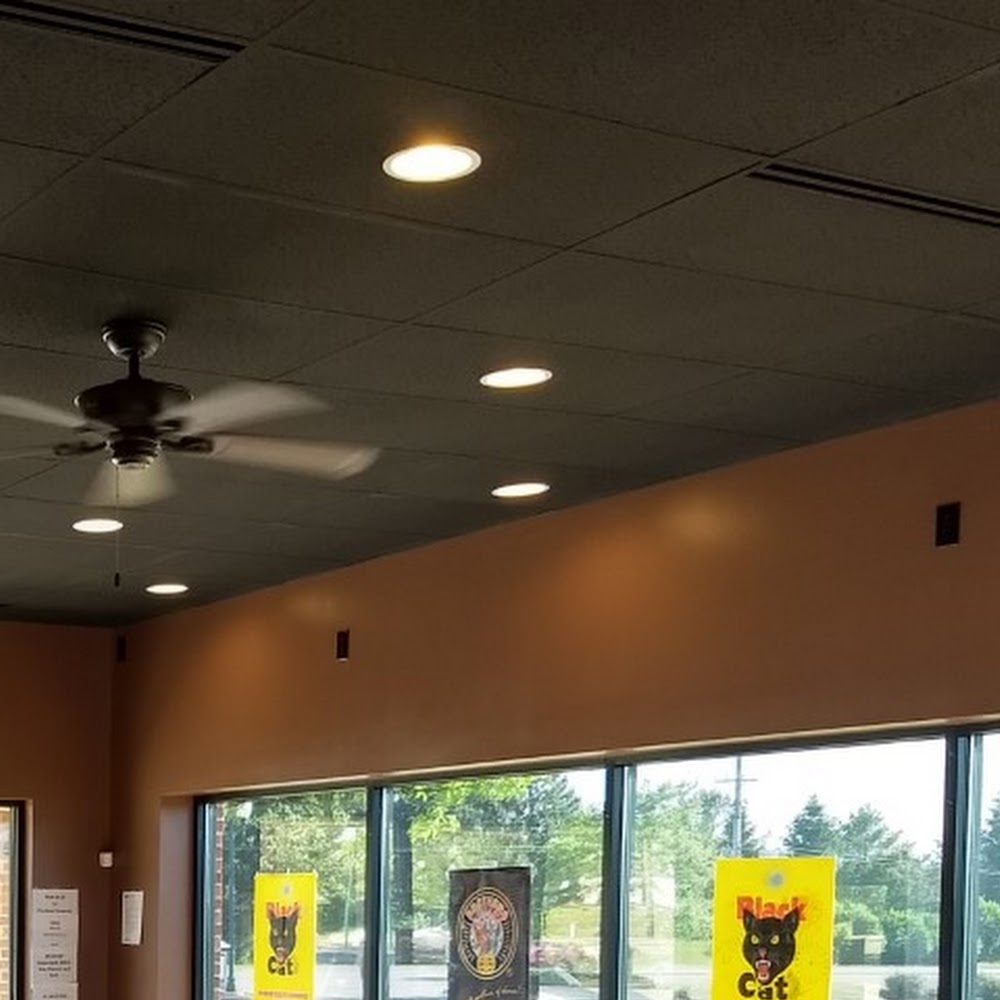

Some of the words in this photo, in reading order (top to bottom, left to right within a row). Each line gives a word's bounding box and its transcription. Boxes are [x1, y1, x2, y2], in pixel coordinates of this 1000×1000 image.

[736, 895, 807, 921] Black
[267, 956, 295, 976] Cat
[737, 972, 788, 1000] Cat
